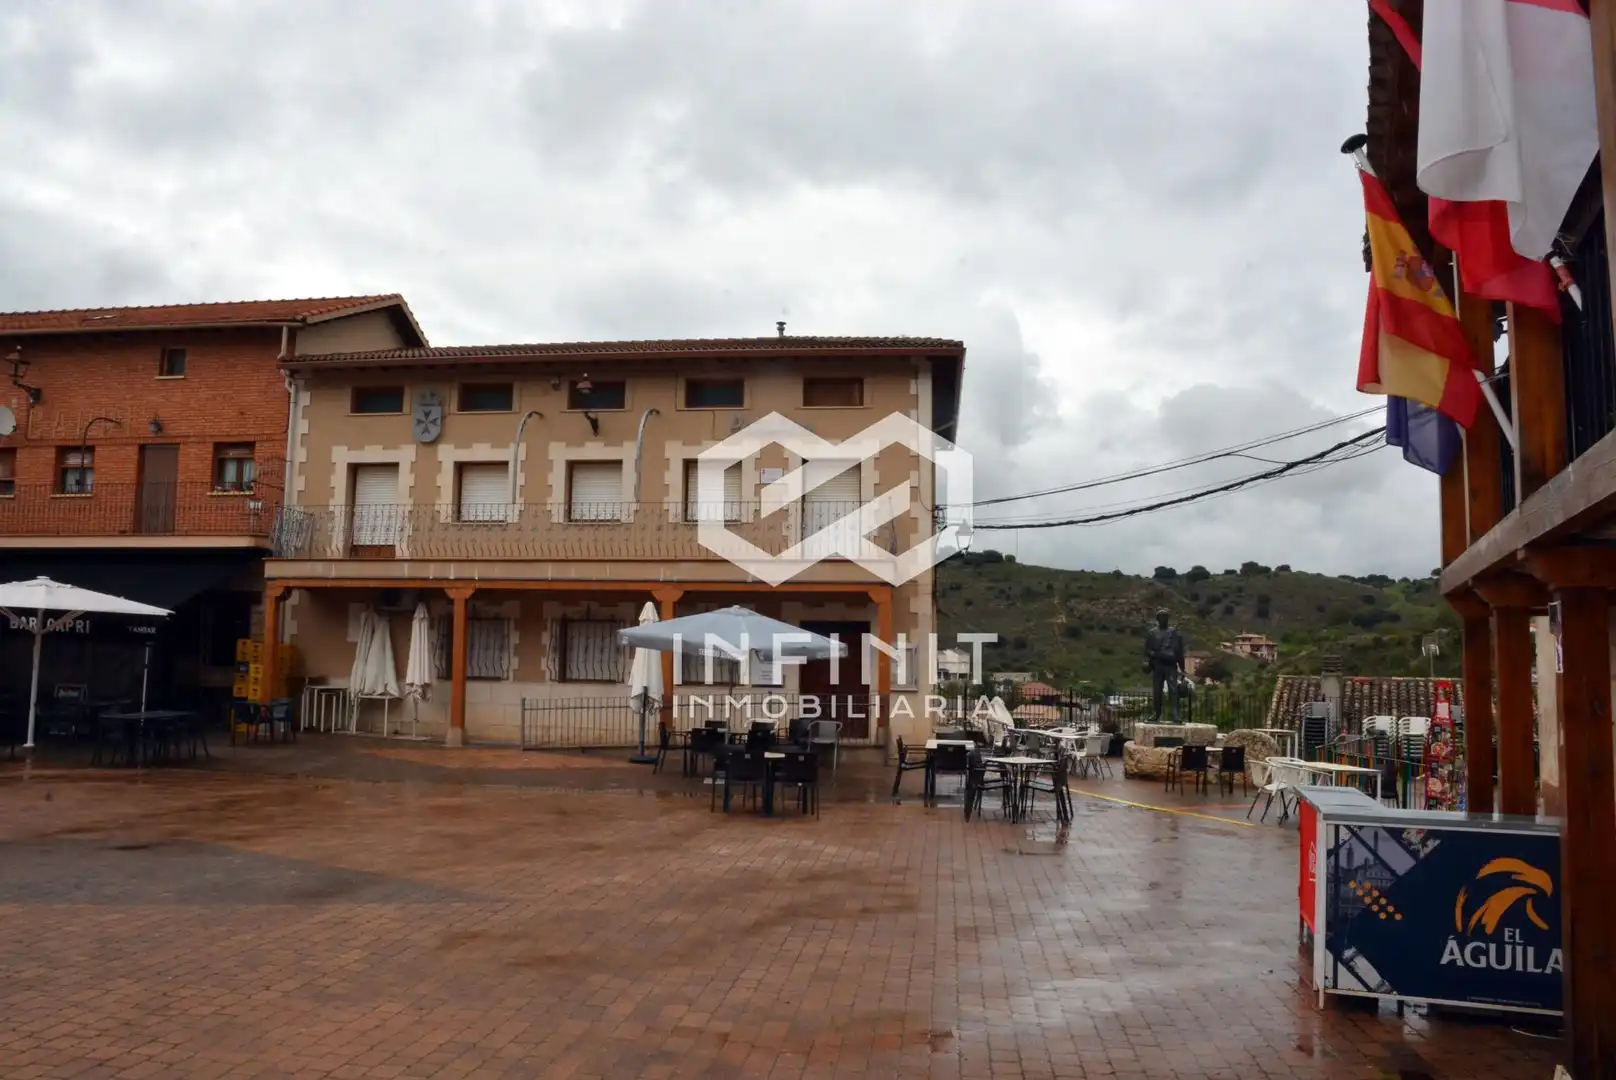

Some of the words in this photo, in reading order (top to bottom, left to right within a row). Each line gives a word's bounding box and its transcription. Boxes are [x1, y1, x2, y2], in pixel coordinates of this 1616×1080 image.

[10, 616, 38, 630] BAR
[47, 617, 91, 634] CAPRI
[1504, 928, 1524, 943] EL
[1440, 935, 1563, 974] ÁGUILA
